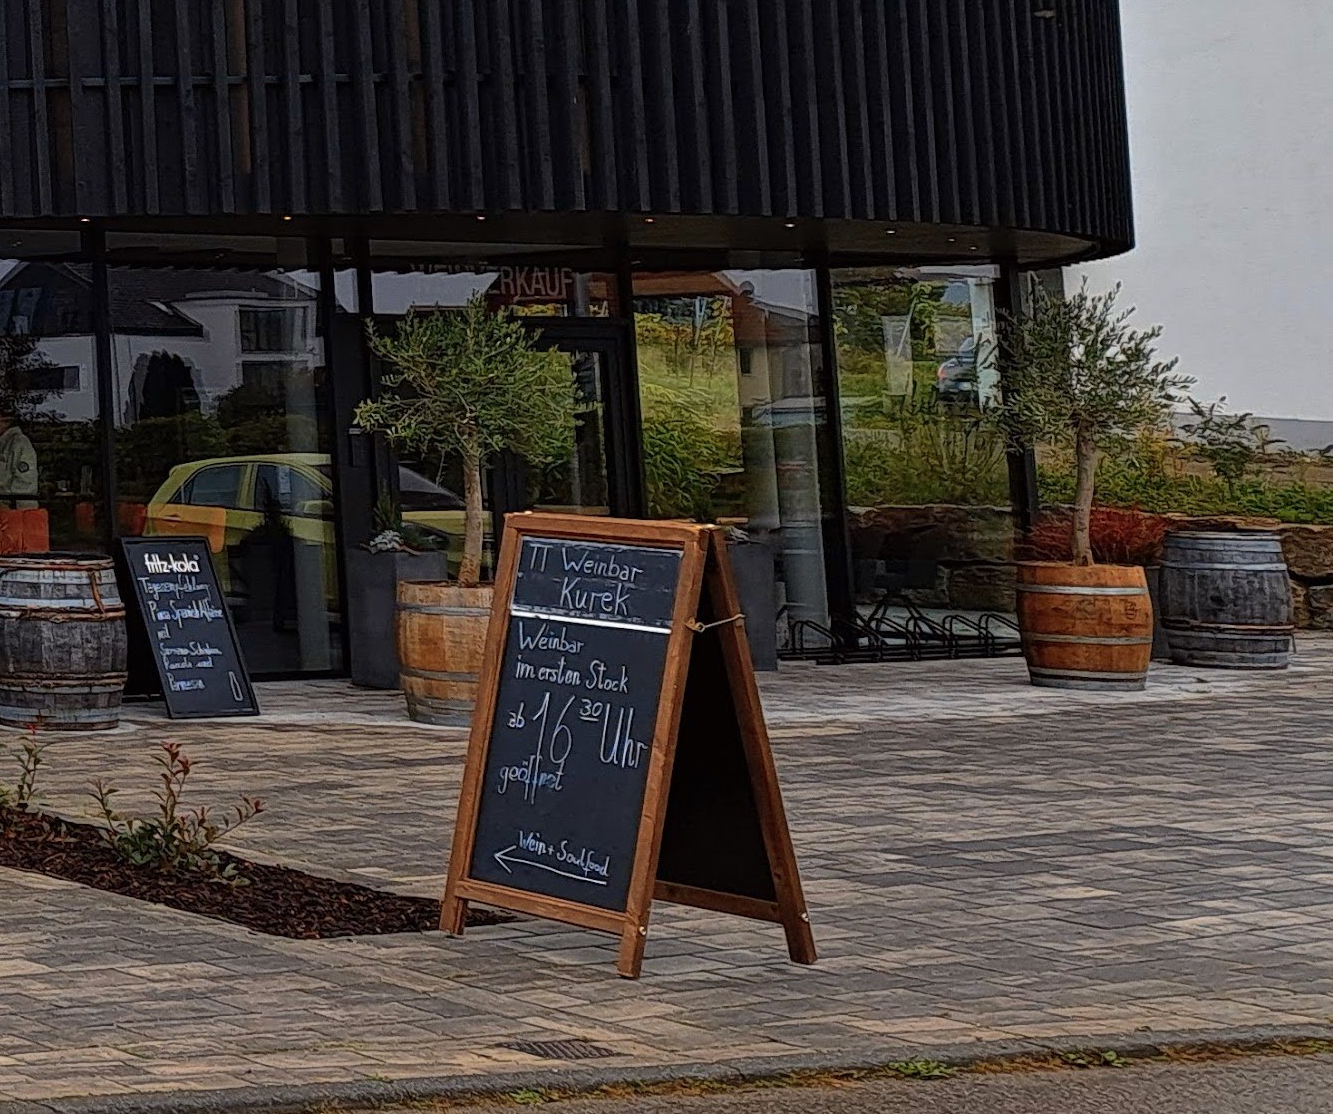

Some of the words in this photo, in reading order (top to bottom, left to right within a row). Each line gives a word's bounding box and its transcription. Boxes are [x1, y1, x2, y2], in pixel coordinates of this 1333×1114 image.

[561, 547, 643, 582] Weinbar
[560, 577, 630, 616] Kurek
[518, 621, 584, 653] Weinbar
[516, 655, 535, 679] im
[538, 656, 581, 686] ersten
[586, 659, 629, 693] Stock
[507, 702, 525, 728] ab
[533, 692, 575, 764] 16
[600, 703, 648, 768] Uhr
[498, 755, 564, 804] geöffnet
[557, 840, 609, 877] Soulfood
